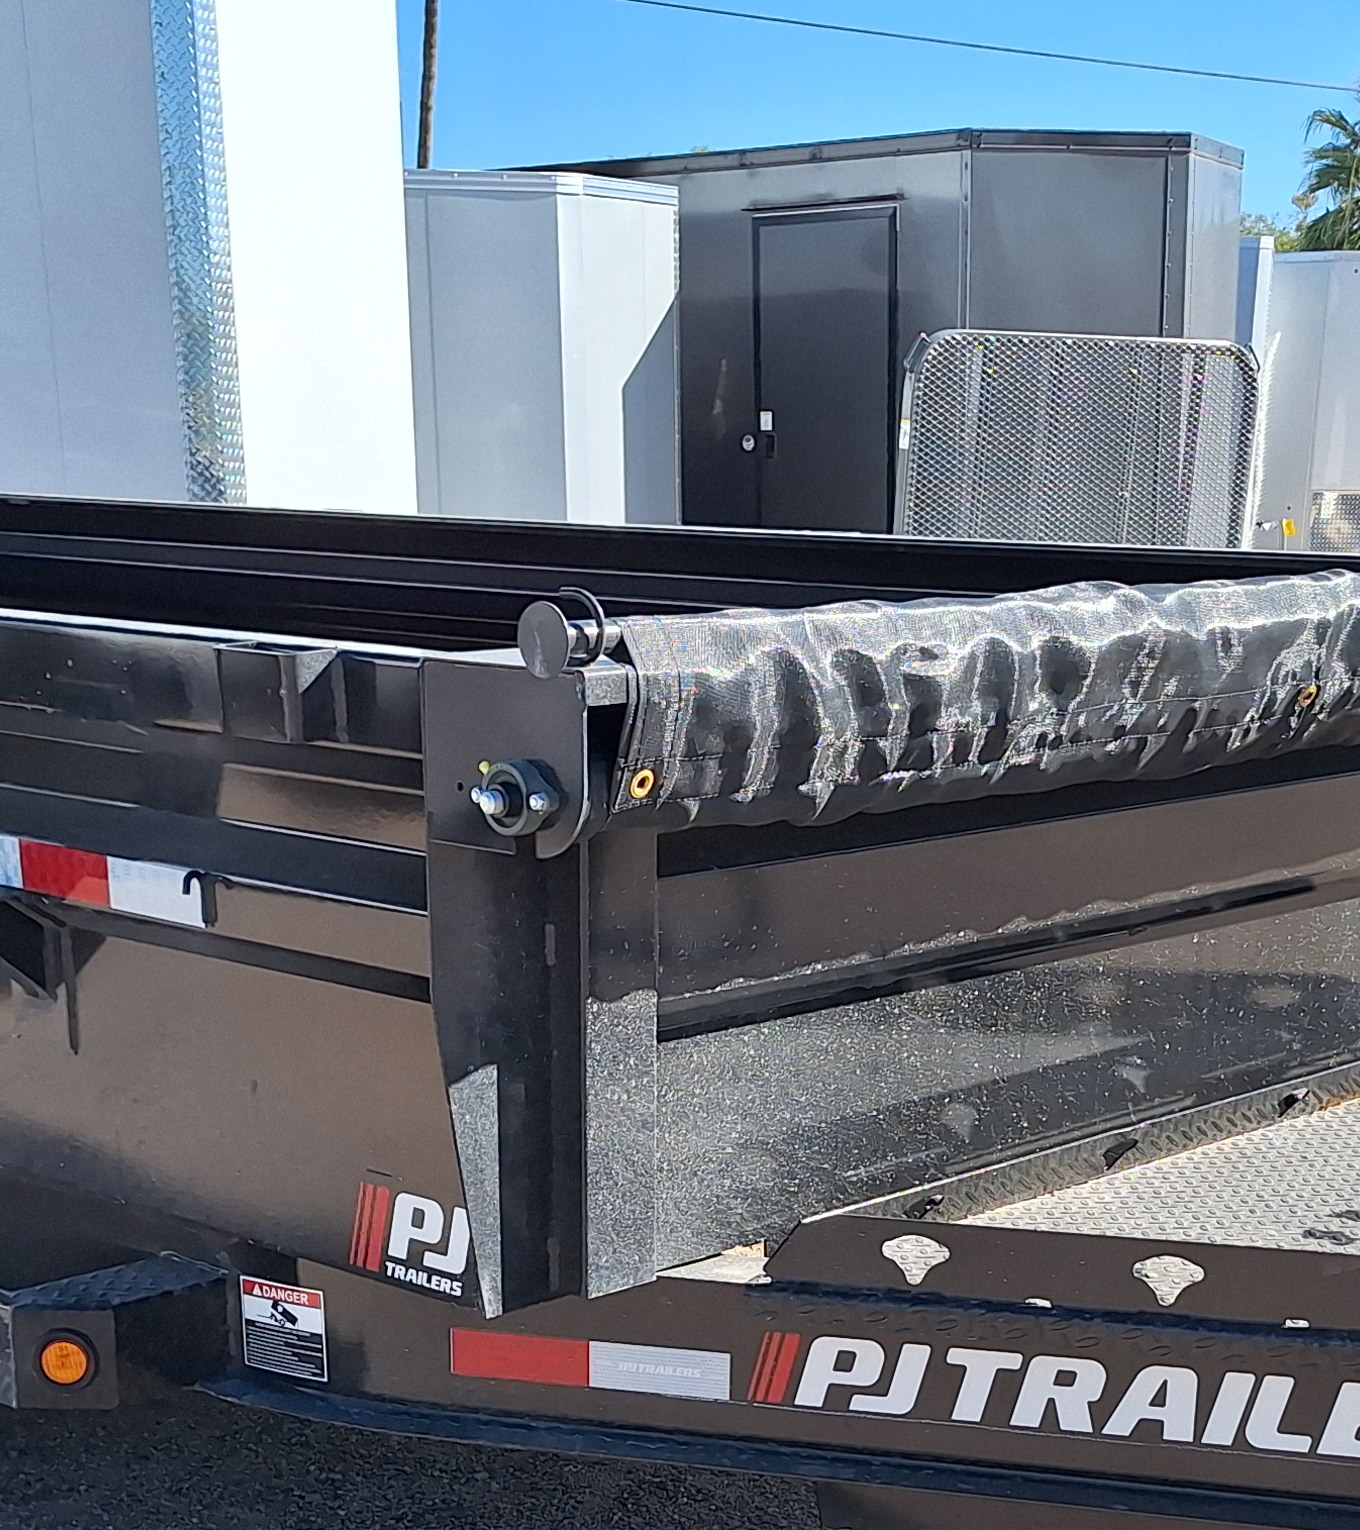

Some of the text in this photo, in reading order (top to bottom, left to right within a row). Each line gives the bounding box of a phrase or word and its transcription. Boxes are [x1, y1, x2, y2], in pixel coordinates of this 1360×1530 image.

[388, 1192, 471, 1275] PJ
[262, 1285, 309, 1305] DANGER
[385, 1261, 463, 1297] TRAILERS
[794, 1335, 932, 1415] PJ
